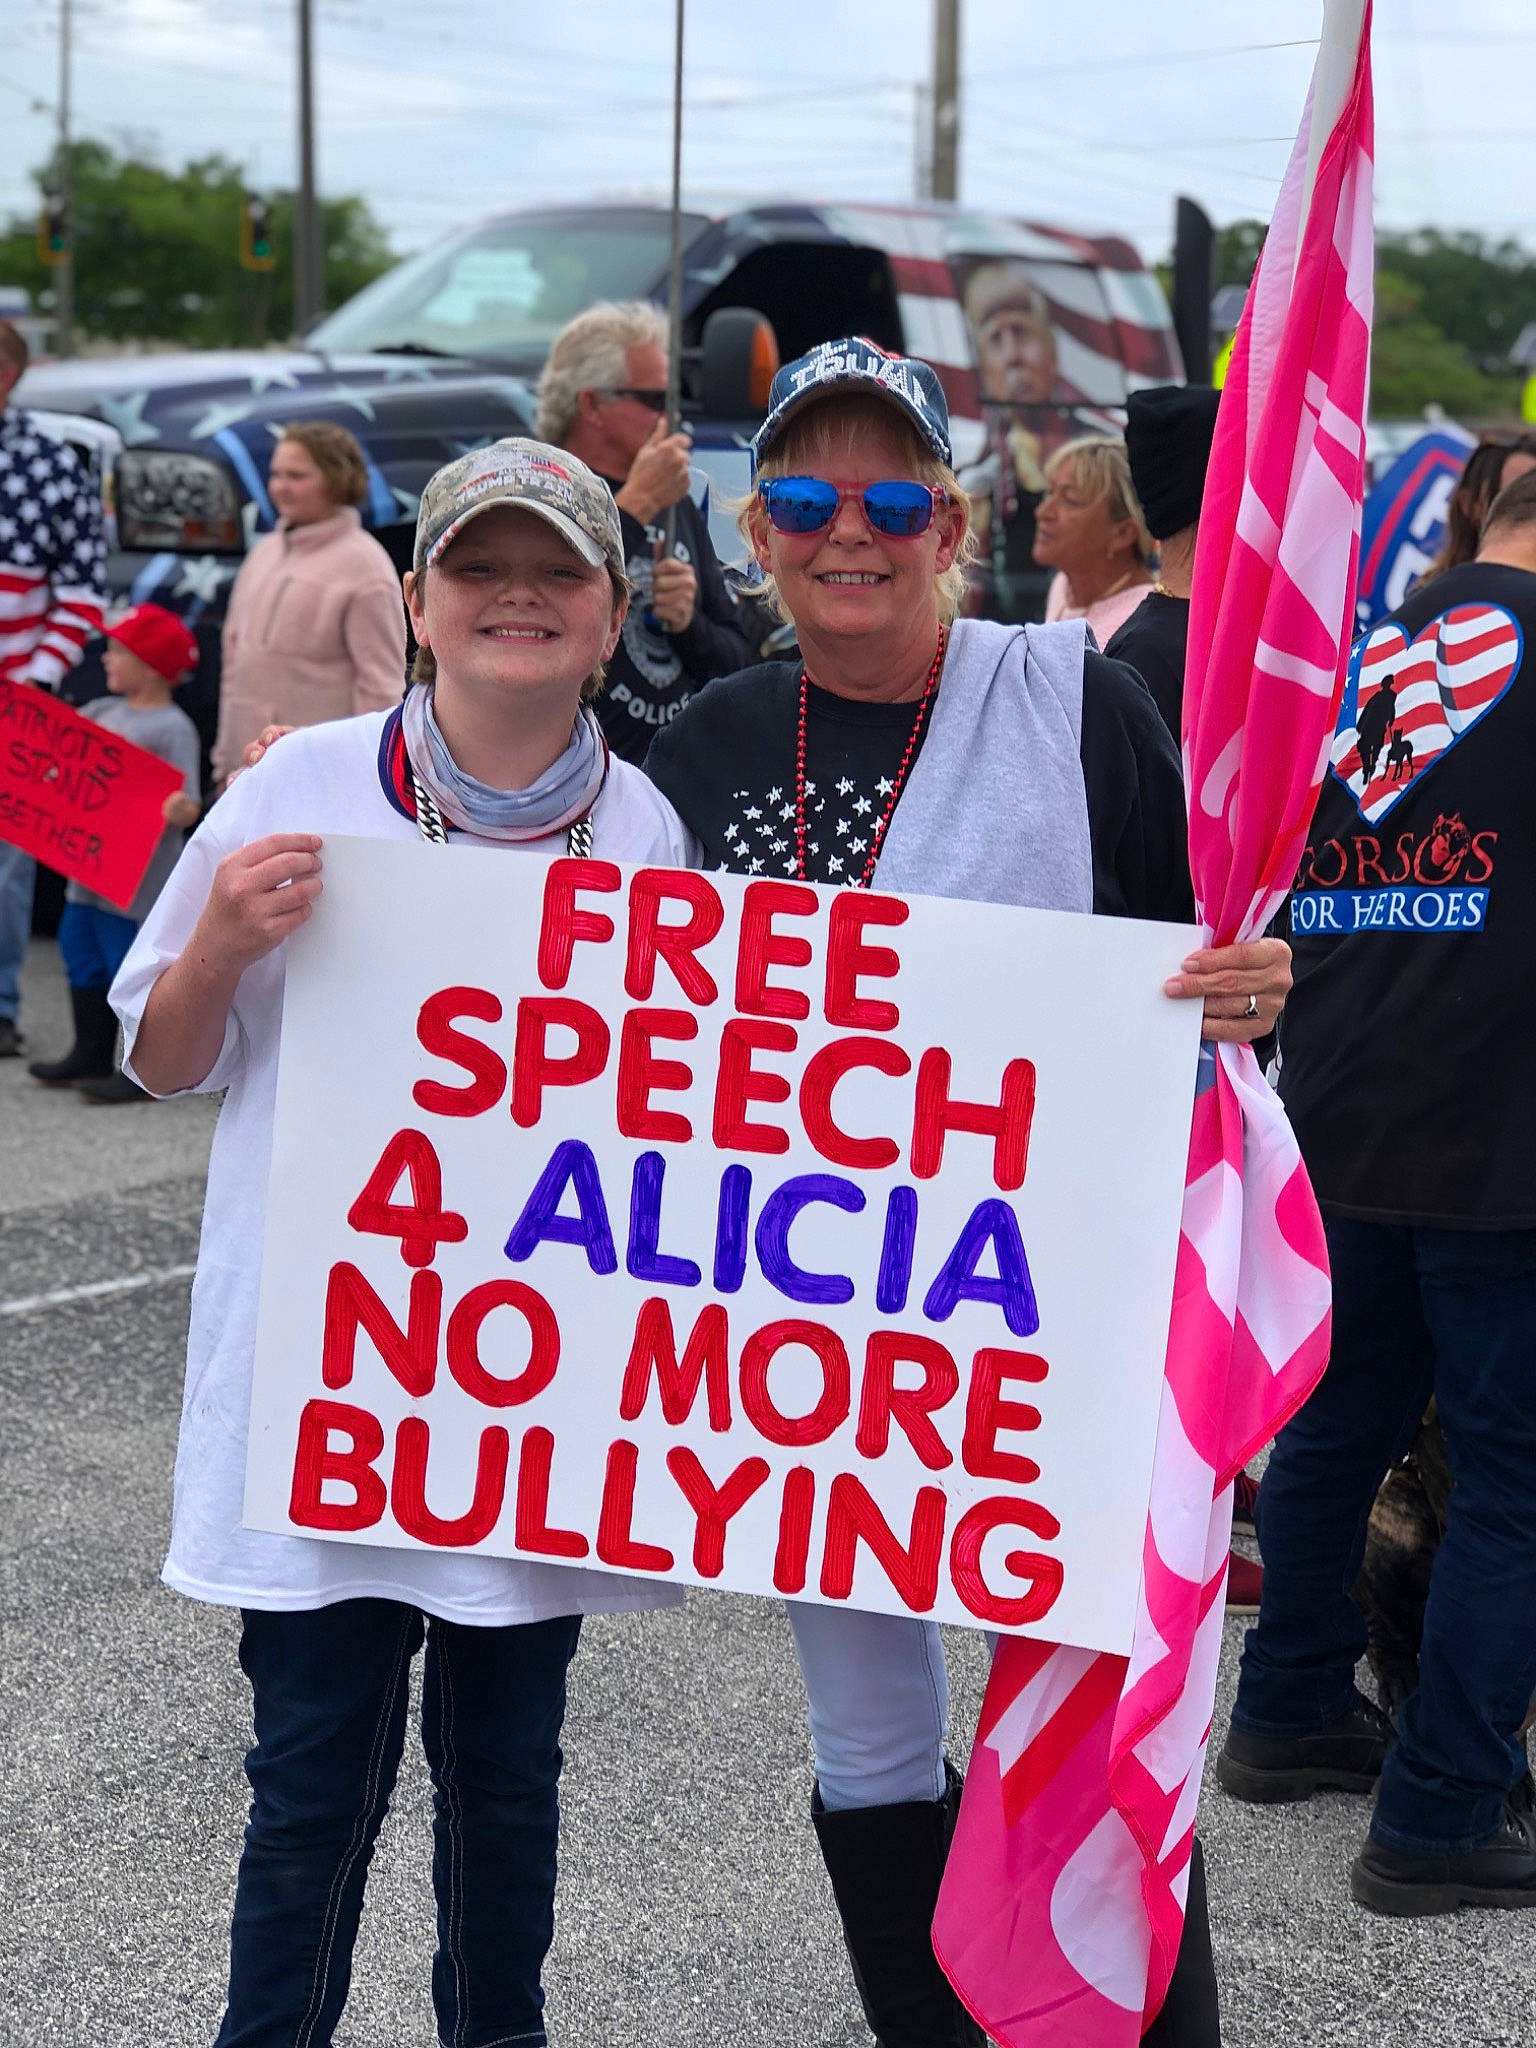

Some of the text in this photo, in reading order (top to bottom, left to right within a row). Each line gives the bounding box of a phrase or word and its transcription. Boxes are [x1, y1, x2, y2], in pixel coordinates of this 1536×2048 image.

[456, 474, 574, 504] TRUMP TRAIN
[7, 740, 110, 812] STAND
[537, 858, 910, 1033] FREE
[1291, 892, 1485, 932] FOR HEROES
[413, 986, 1037, 1193] SPEECH
[347, 1128, 1041, 1339] 4 ALICIA
[322, 1261, 1050, 1485] NO MORE
[288, 1398, 1065, 1627] BULLYING
